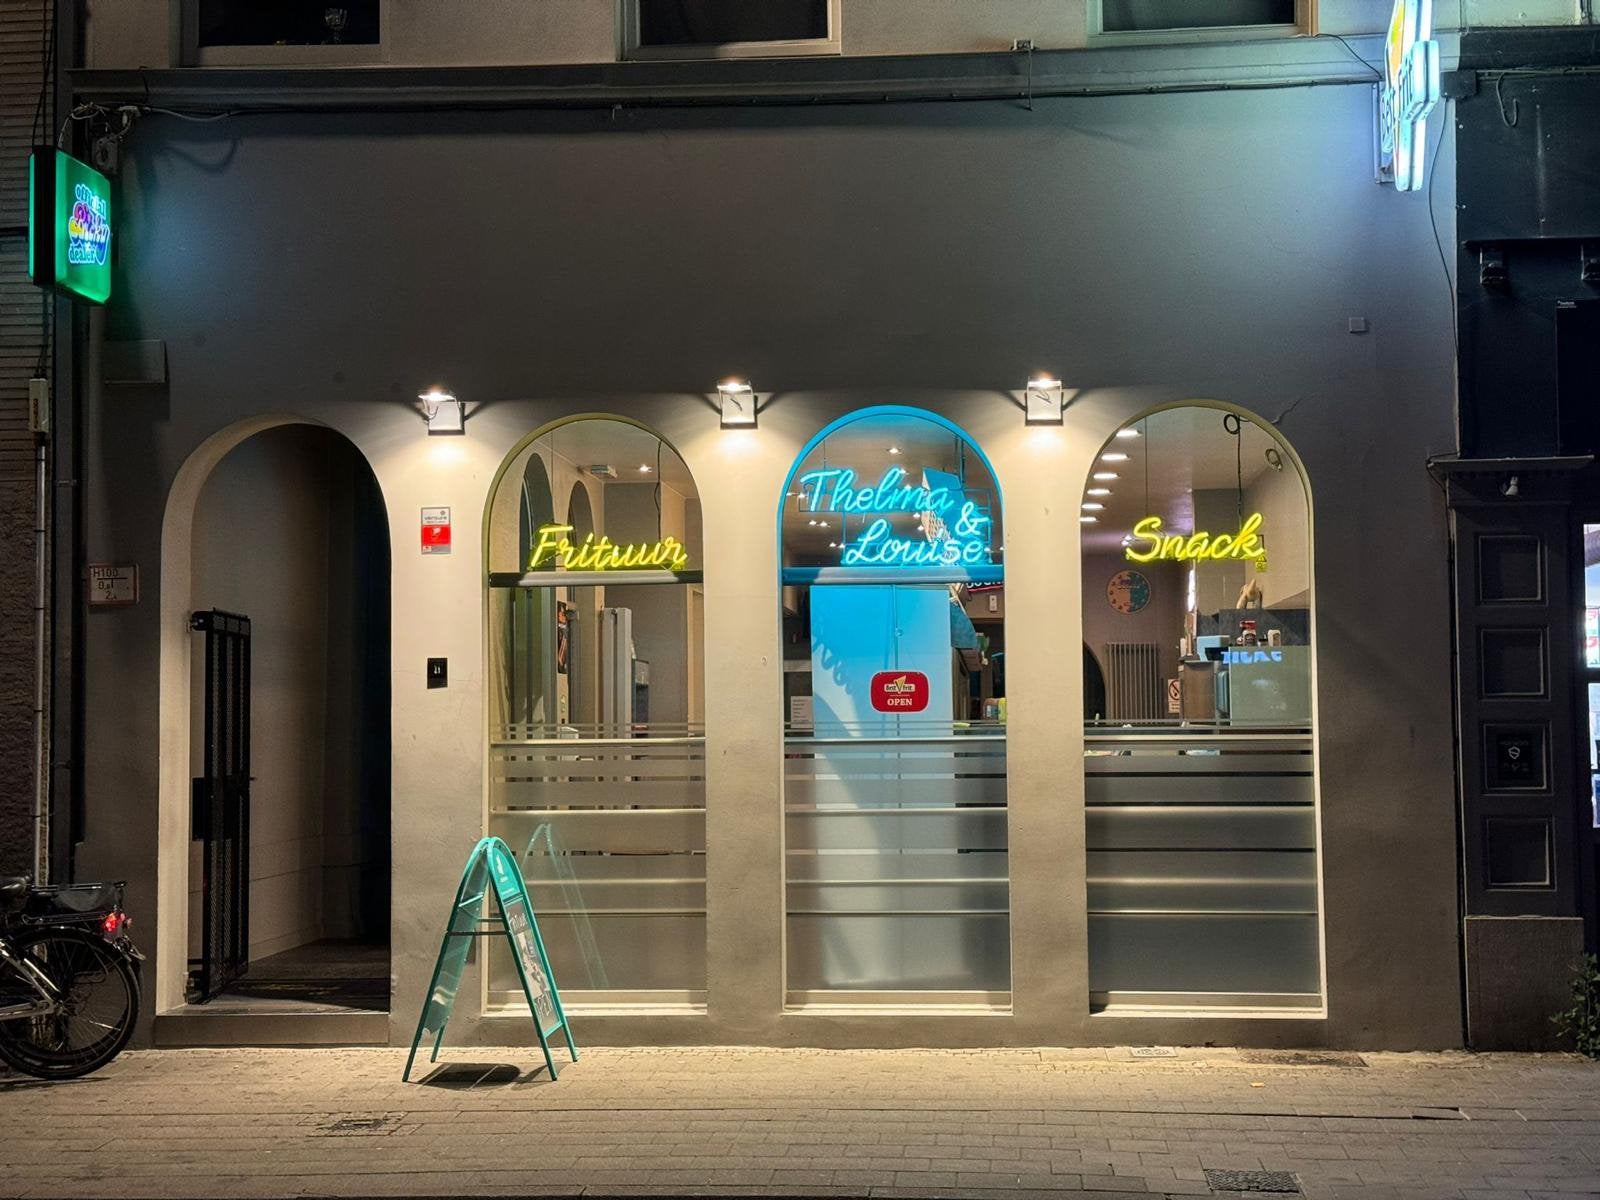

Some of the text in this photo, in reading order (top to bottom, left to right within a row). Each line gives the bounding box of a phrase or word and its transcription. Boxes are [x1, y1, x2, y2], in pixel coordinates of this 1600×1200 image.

[800, 466, 990, 536] Thelma &
[529, 524, 688, 570] Frituur
[845, 518, 984, 565] Louise
[1125, 512, 1265, 562] Snack
[886, 698, 913, 706] OPEN
